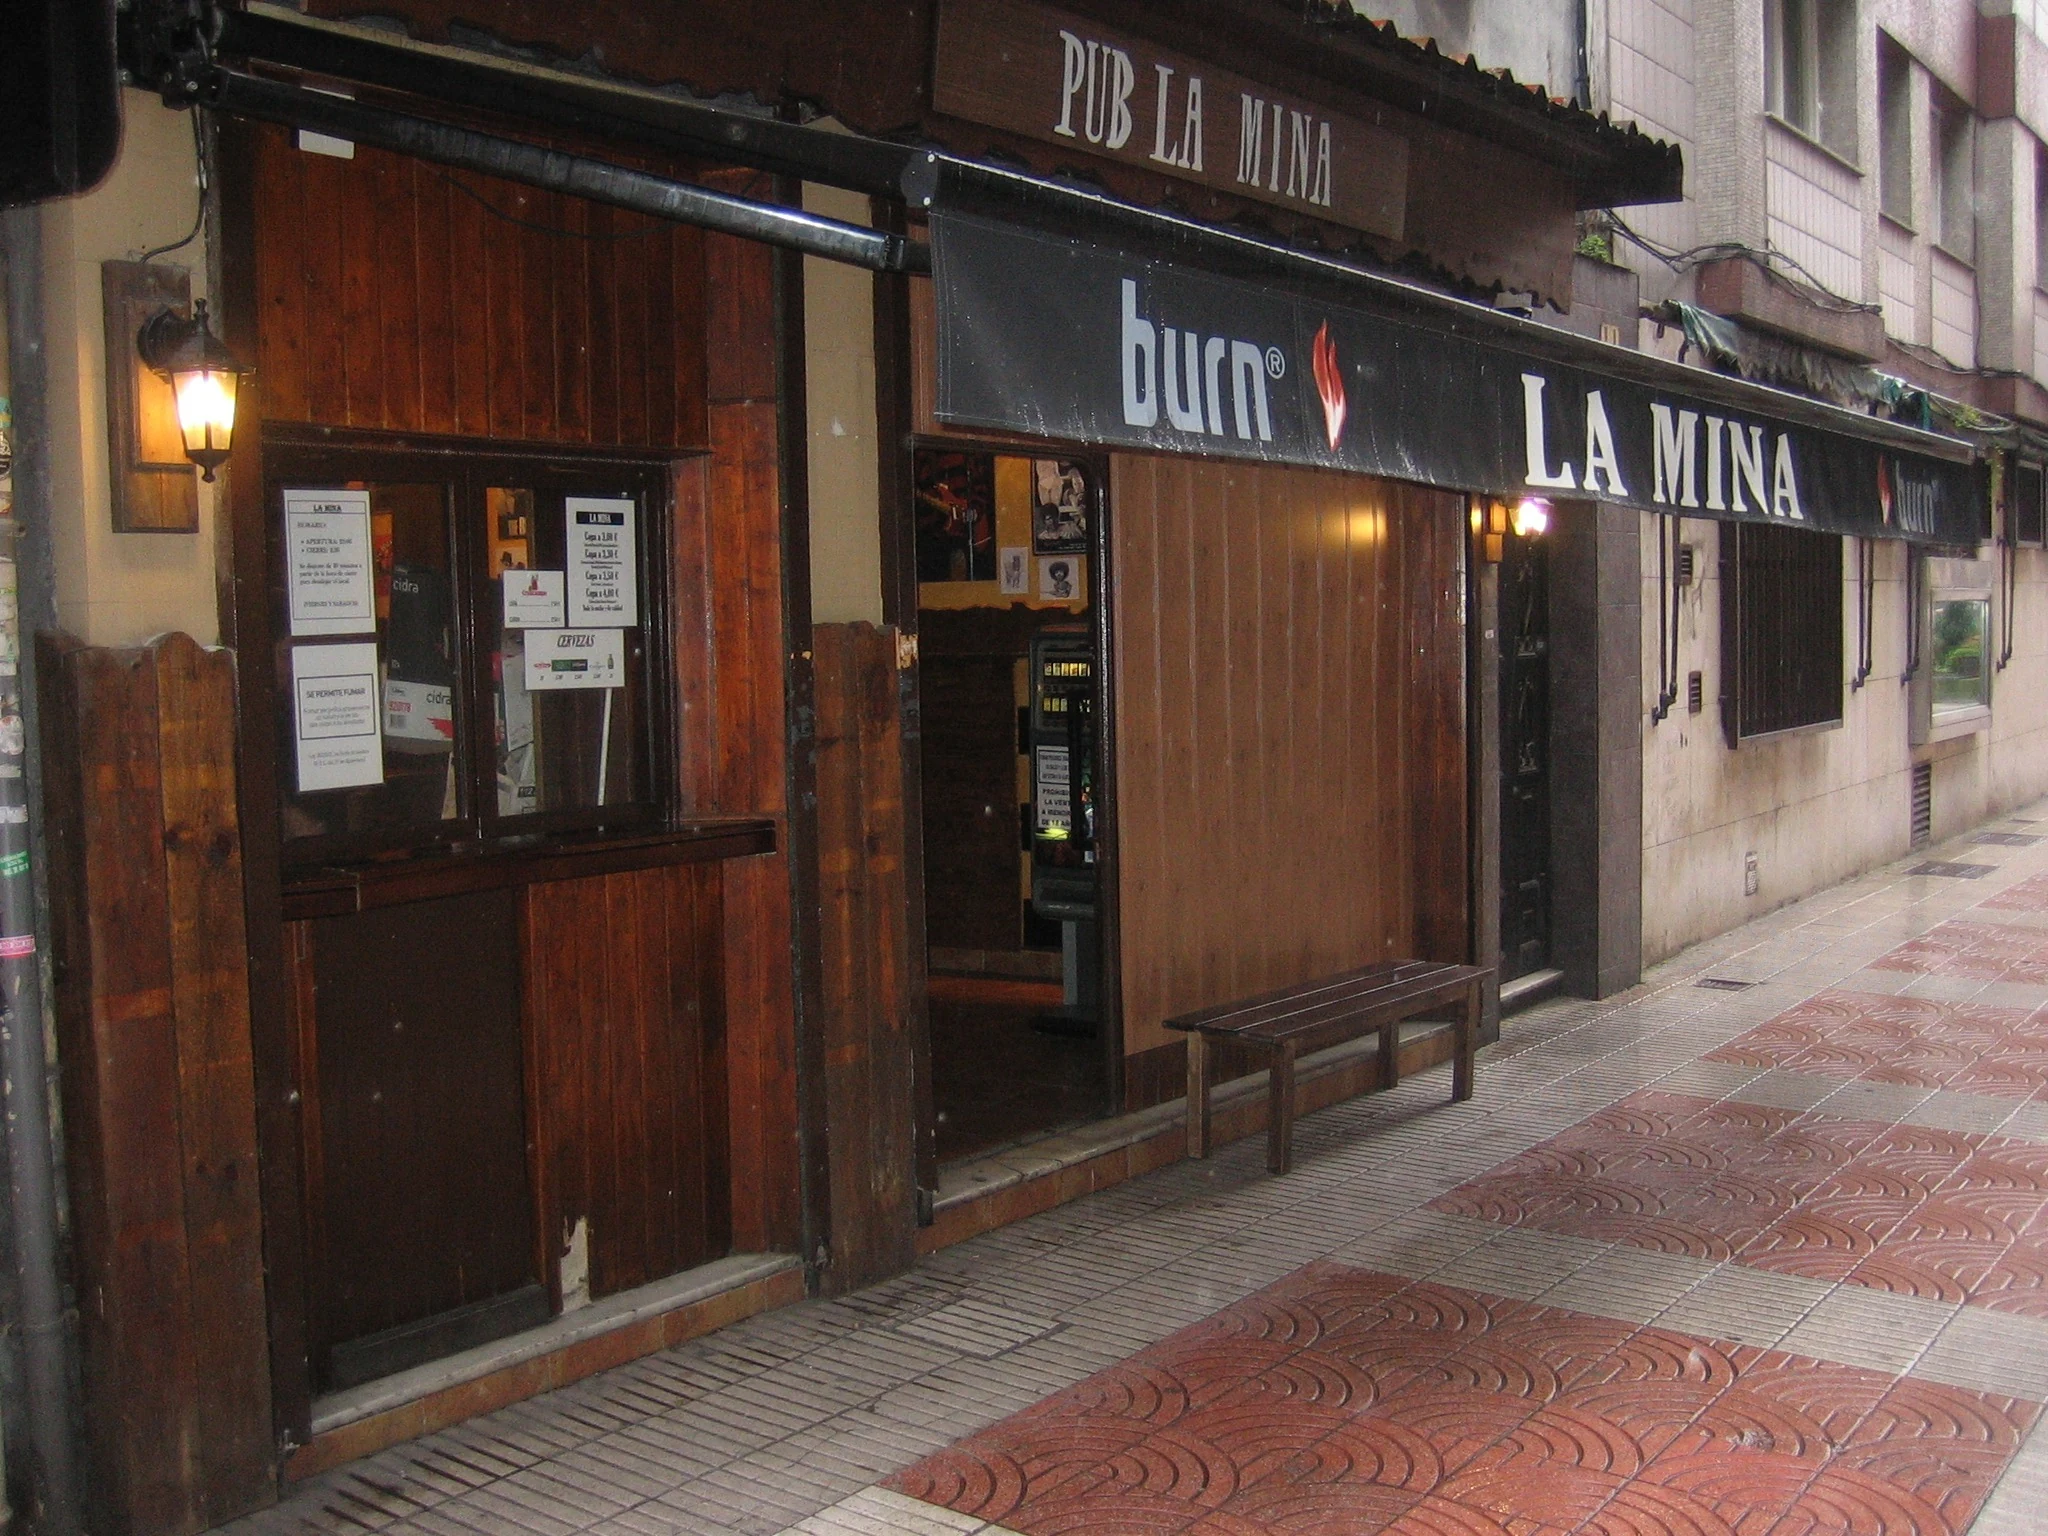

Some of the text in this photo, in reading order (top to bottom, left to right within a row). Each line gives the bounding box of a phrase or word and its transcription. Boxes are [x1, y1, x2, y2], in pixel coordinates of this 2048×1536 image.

[1054, 30, 1332, 207] PUB LA MINA
[1521, 373, 1804, 520] LA MINA
[393, 577, 419, 593] cidra
[557, 634, 596, 648] CERVEZAS
[426, 688, 452, 706] cidra
